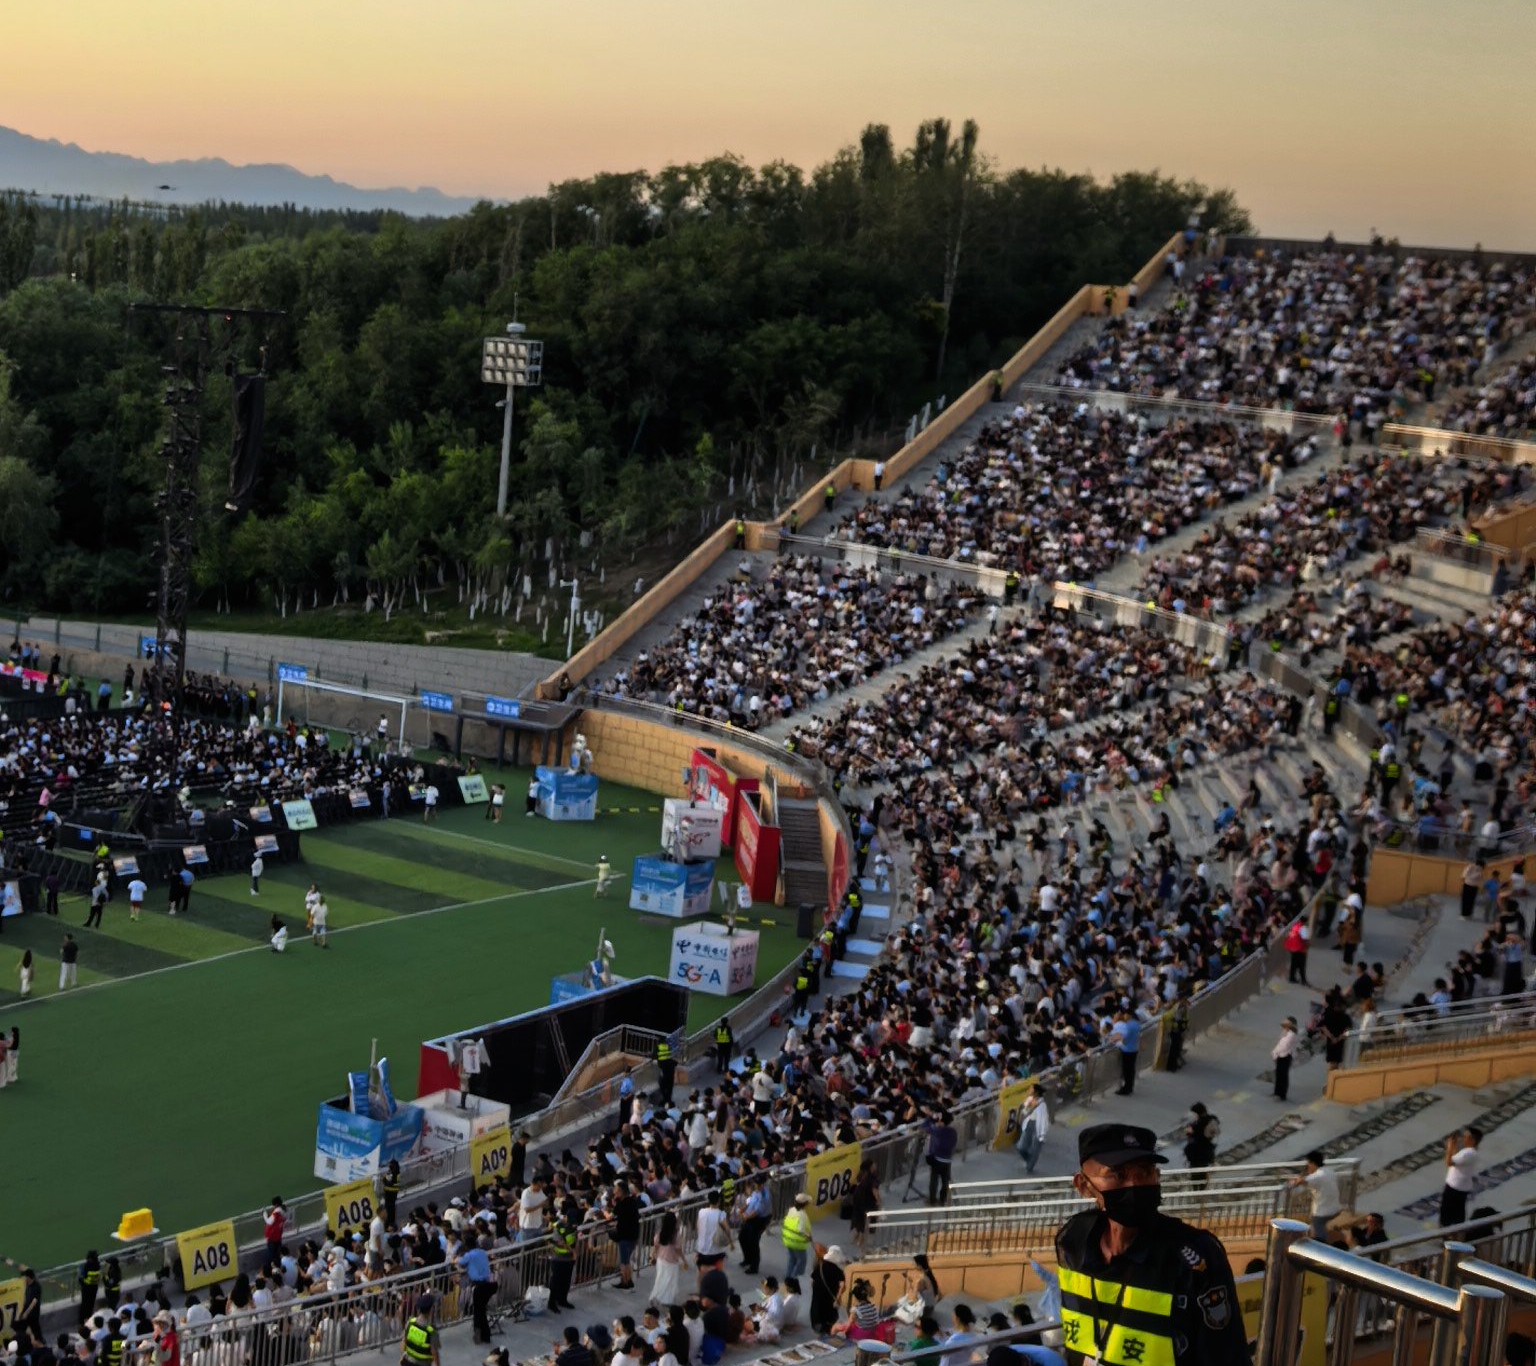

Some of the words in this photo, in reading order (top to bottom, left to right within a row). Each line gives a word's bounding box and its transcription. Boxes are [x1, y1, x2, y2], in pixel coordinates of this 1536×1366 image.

[481, 1146, 507, 1175] A09
[816, 1168, 852, 1206] B08
[338, 1197, 373, 1229] A08
[194, 1242, 230, 1275] A08
[1123, 1337, 1146, 1364] 安
